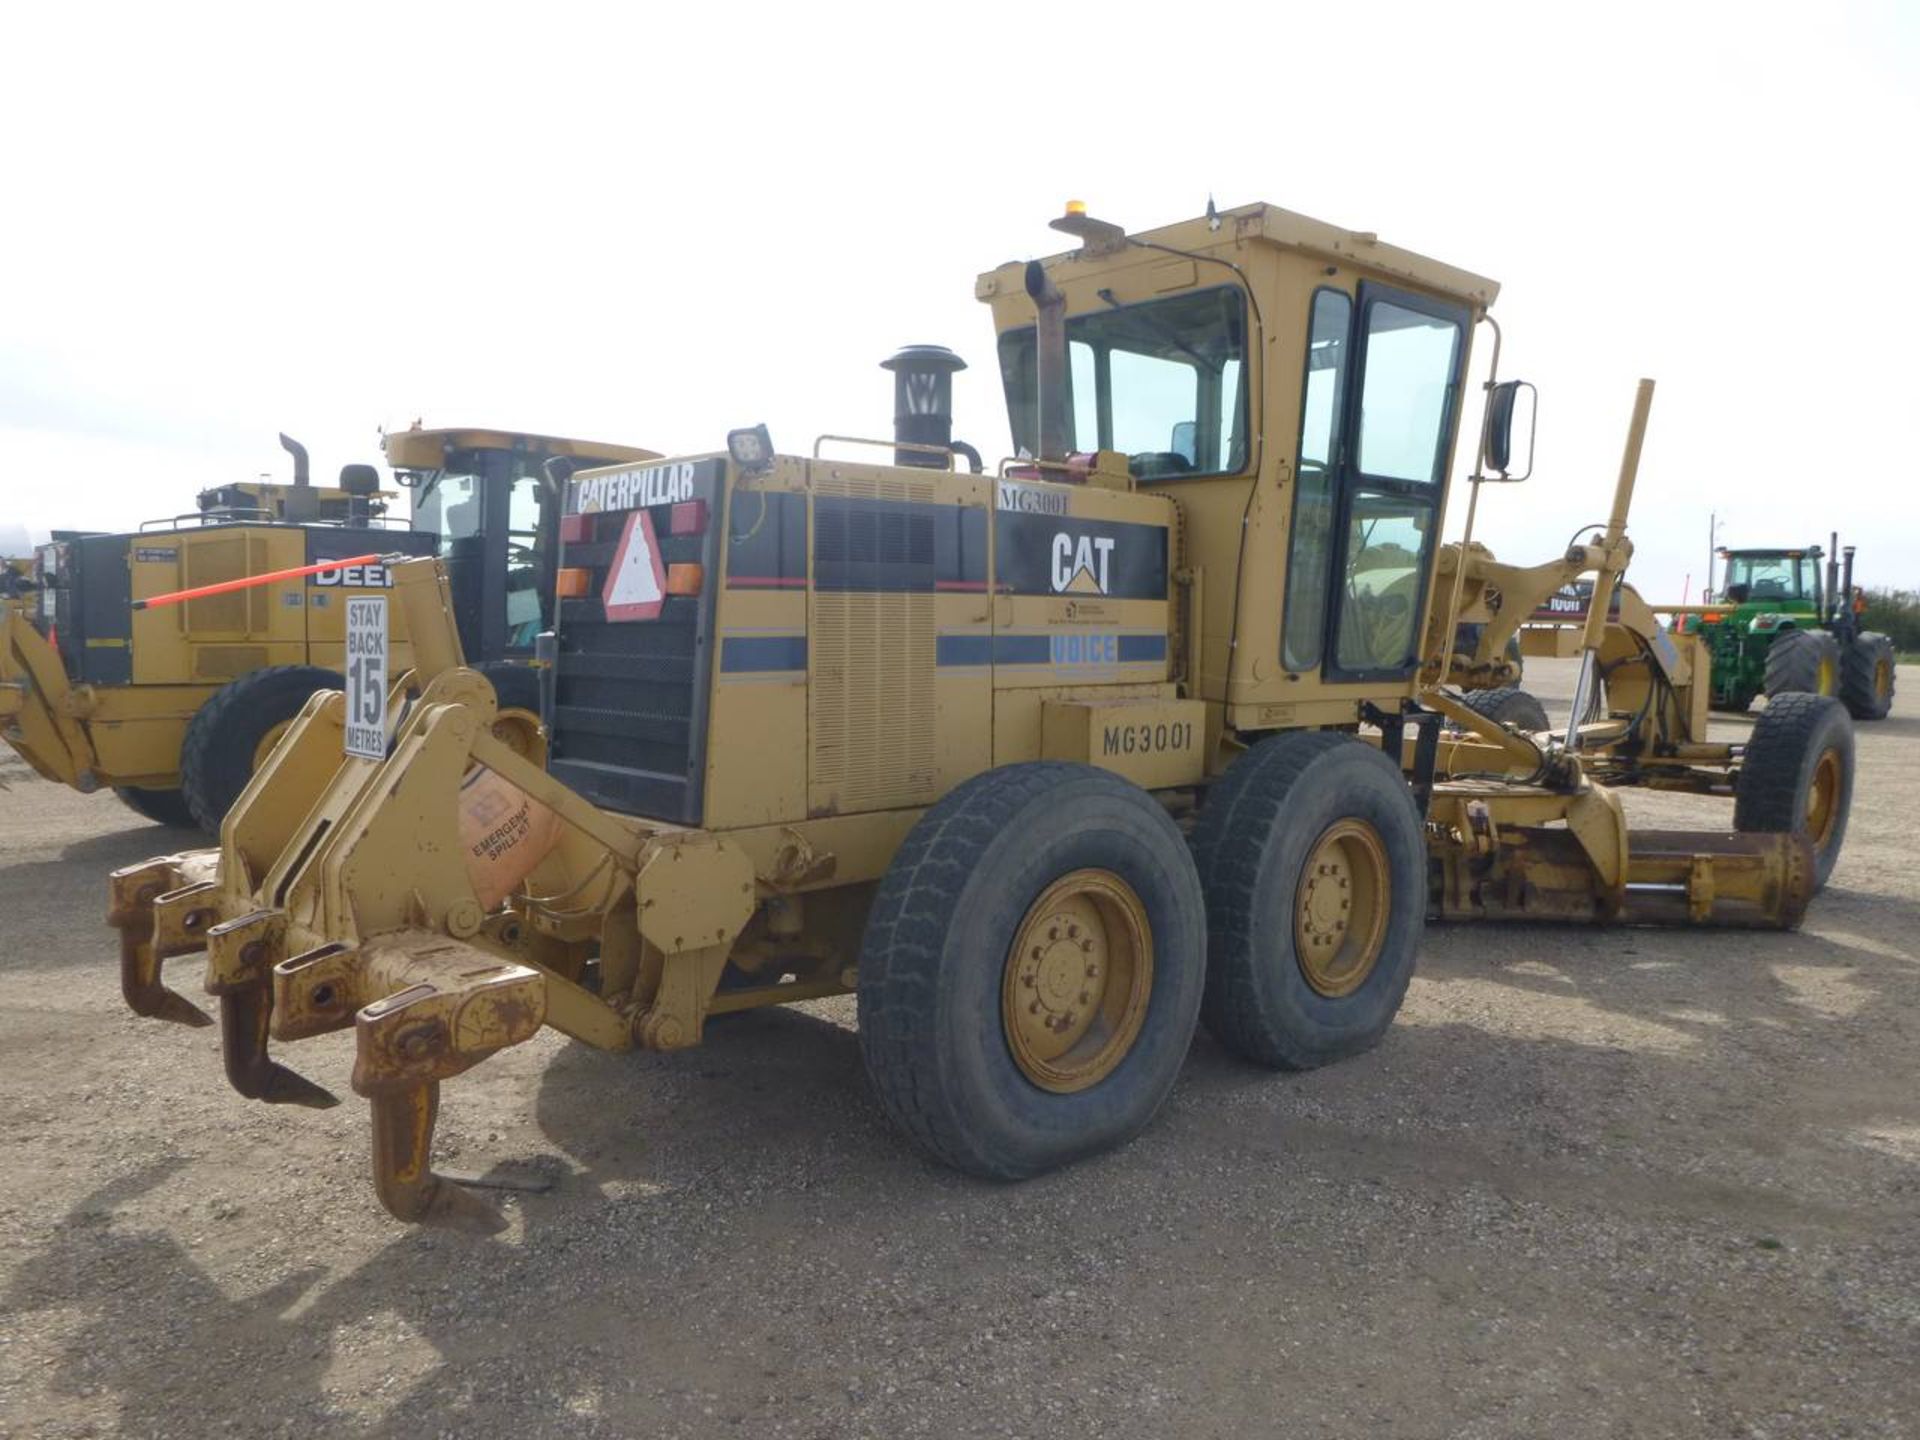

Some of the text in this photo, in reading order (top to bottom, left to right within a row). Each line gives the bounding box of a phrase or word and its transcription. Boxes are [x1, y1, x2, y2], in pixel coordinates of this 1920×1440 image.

[577, 463, 695, 514] CATERPILLAR
[1001, 486, 1069, 516] MG3001
[1052, 532, 1115, 595] CAT
[350, 603, 382, 627] STAY
[348, 631, 385, 656] BACK
[349, 657, 382, 725] 15
[346, 726, 383, 753] METRES
[1103, 721, 1192, 756] MG3001
